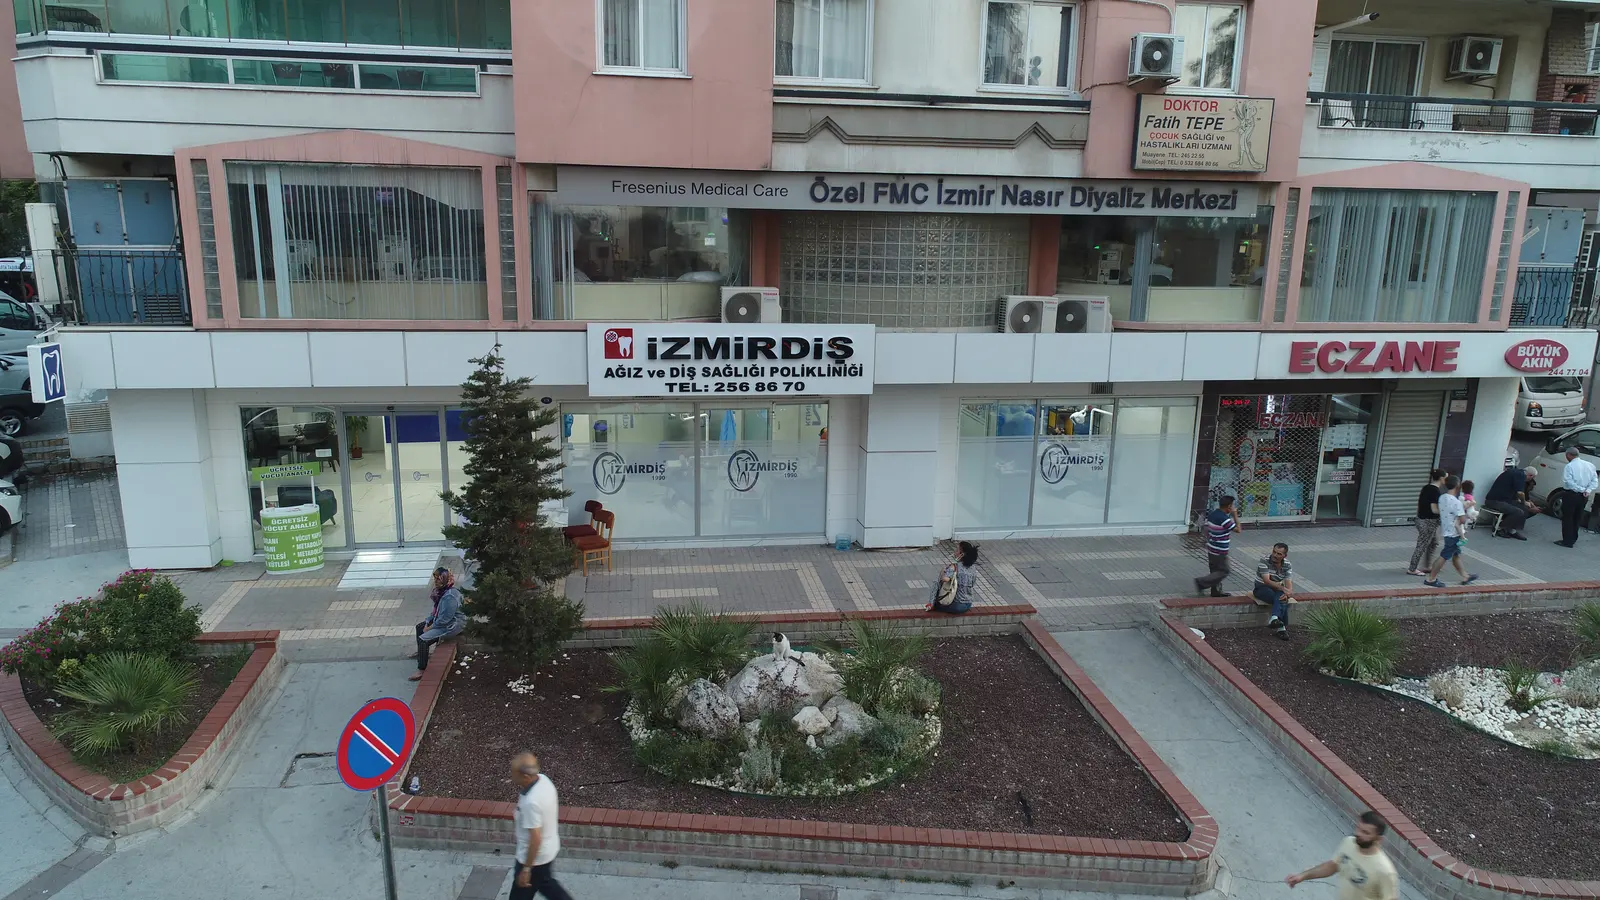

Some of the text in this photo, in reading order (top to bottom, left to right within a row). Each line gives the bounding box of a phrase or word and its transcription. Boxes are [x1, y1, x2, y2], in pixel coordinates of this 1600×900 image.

[1164, 99, 1218, 112] DOKTOR
[1144, 115, 1225, 130] Fatih TEPE
[1181, 132, 1214, 140] SAĞLIĞI
[1140, 141, 1200, 149] HASTALIKLARI
[612, 180, 788, 196] Fresenius Medical Care
[810, 176, 1238, 212] Özel FMC İzmir Nasır Diyaliz Merkezi
[1289, 341, 1460, 373] ECZANE
[1517, 345, 1562, 357] BÜYÜK
[1521, 357, 1552, 368] AKIN
[604, 363, 863, 380] AĞIZ ve DİŞ SAĞLIĞI POLİKLİNİĞİ
[665, 381, 805, 393] TEL: 256 86 70
[1056, 453, 1104, 465] İZMİRDİŞ
[611, 462, 666, 475] İZMİRDİŞ
[745, 460, 798, 472] İZMİRDİŞ
